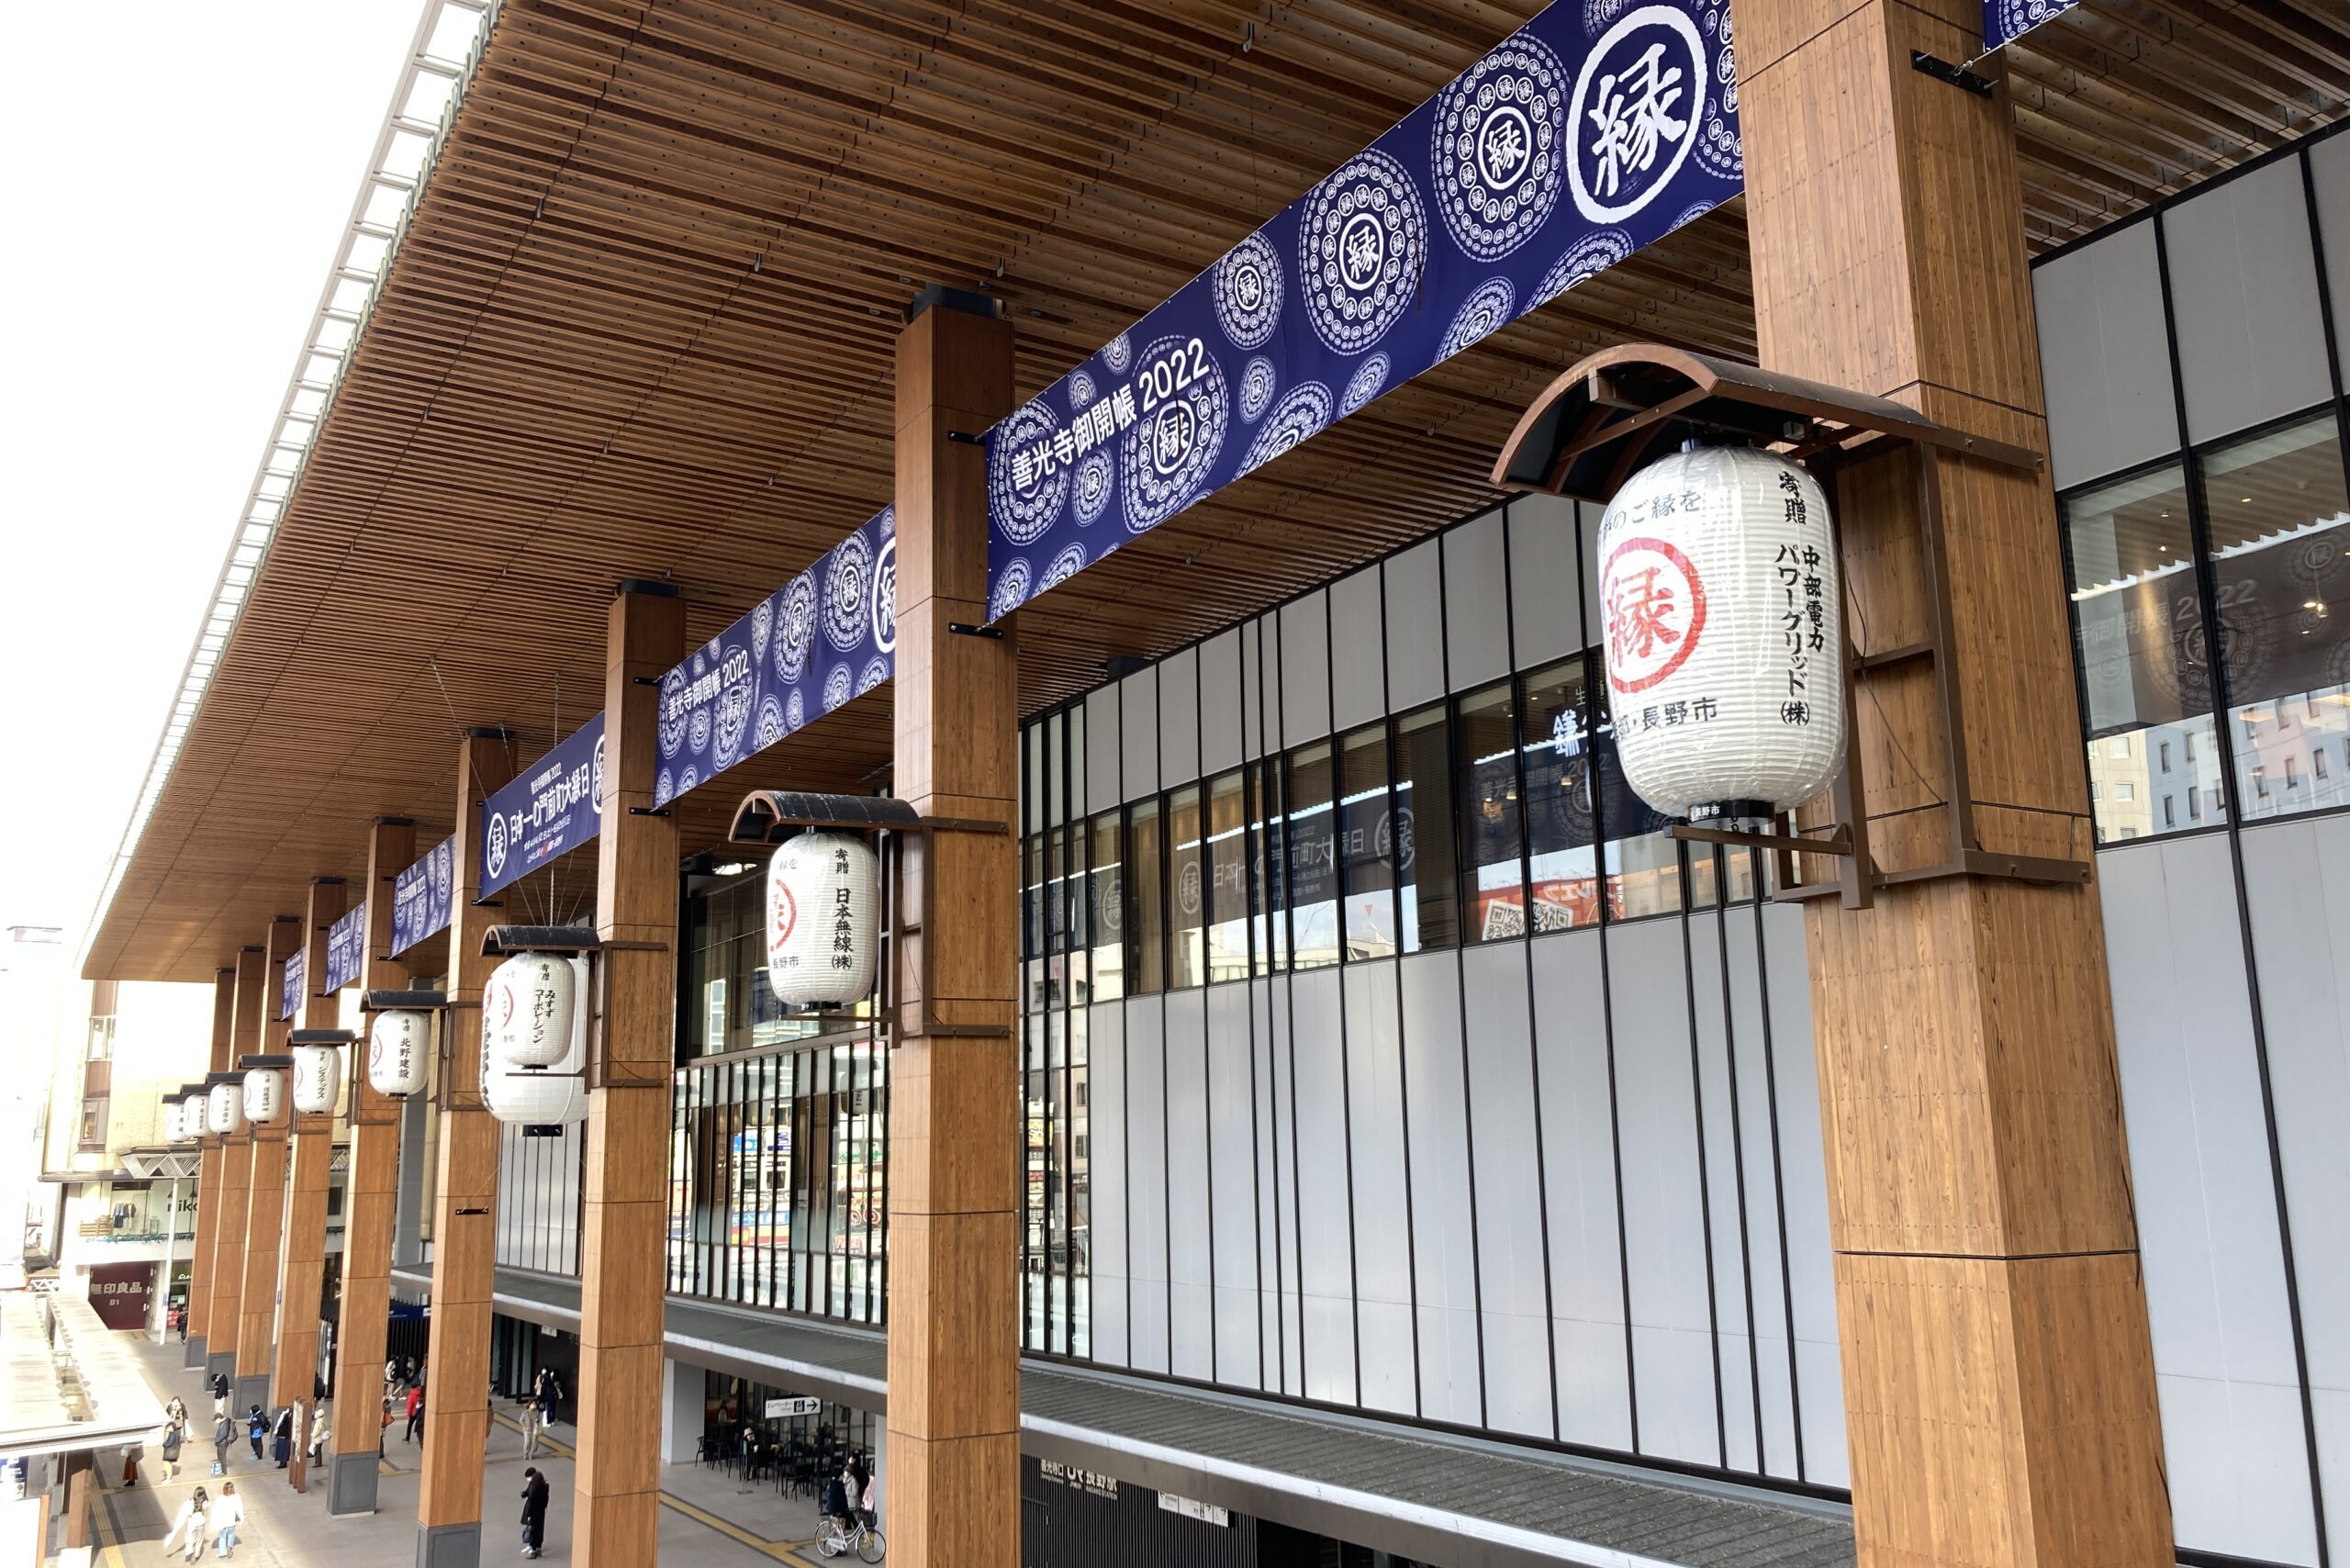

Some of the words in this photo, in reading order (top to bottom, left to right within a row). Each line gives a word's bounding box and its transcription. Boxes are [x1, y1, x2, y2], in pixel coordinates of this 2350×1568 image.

[1588, 43, 1687, 196] 縁
[1485, 120, 1525, 178] 縁
[1346, 226, 1379, 279] 縁
[1239, 274, 1259, 301] 縁
[1011, 384, 1137, 491] 善光寺御開帳
[1138, 337, 1210, 412] 2022
[1158, 417, 1188, 460] 縁
[1778, 471, 1807, 524] 寄贈
[1607, 566, 1681, 667] 縁
[1801, 544, 1824, 654] 中部電力
[668, 667, 721, 721] 善光寺御開帳
[722, 649, 749, 687] 2022
[510, 762, 588, 846] 日本一の門前町大縁日
[834, 848, 849, 874] 寄贈
[831, 888, 854, 969] 日本無線(株)
[532, 989, 544, 1044] コーポレーション
[398, 1038, 411, 1079] 北野建設
[91, 1282, 142, 1295] 無印良品
[1086, 1471, 1117, 1492] 長野駅
